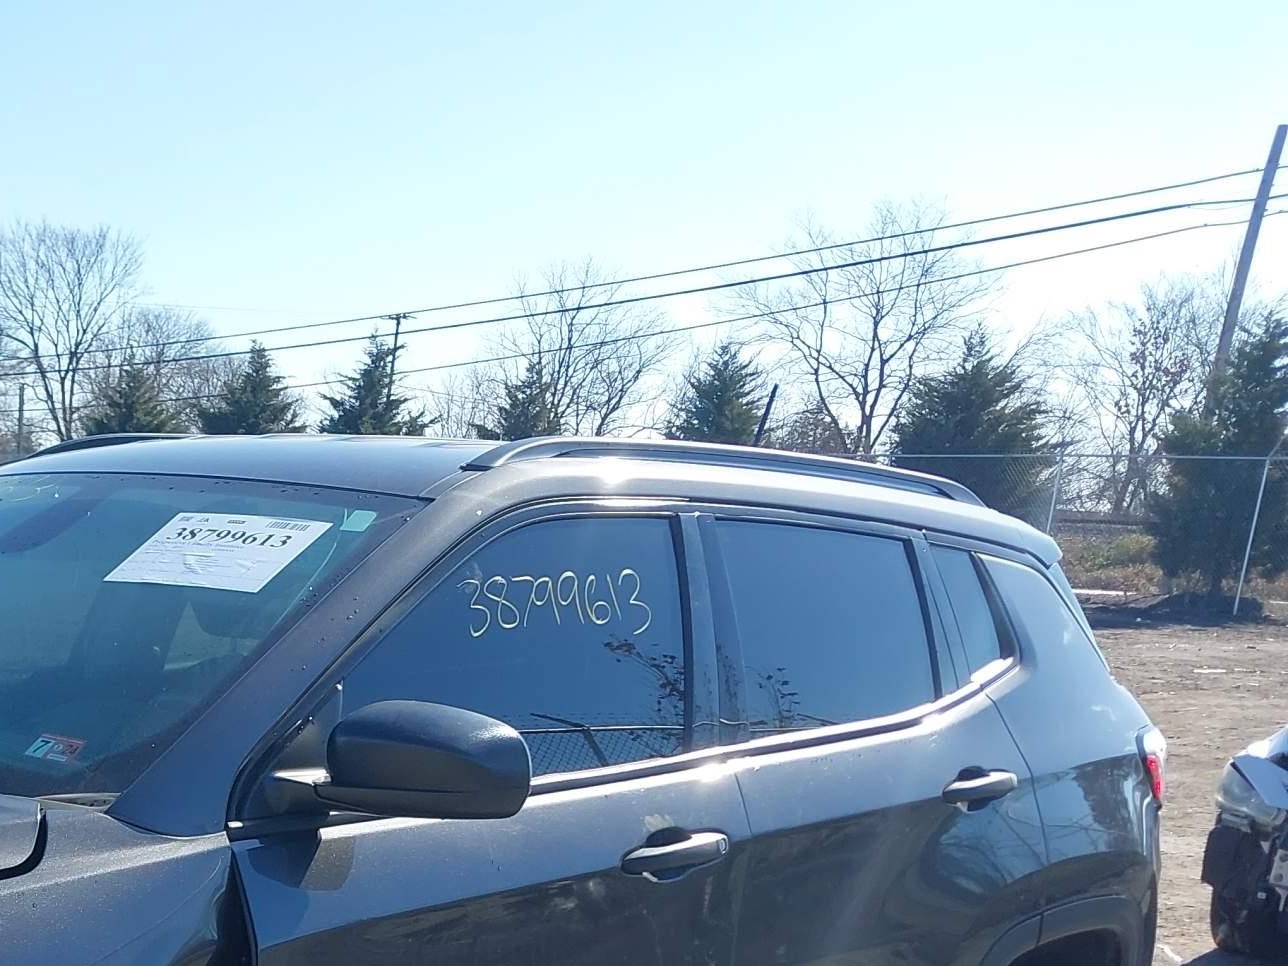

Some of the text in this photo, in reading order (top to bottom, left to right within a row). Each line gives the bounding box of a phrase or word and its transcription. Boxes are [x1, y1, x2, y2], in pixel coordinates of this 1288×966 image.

[166, 527, 293, 549] 38799613
[456, 568, 652, 637] 38799613
[31, 739, 53, 753] 7
